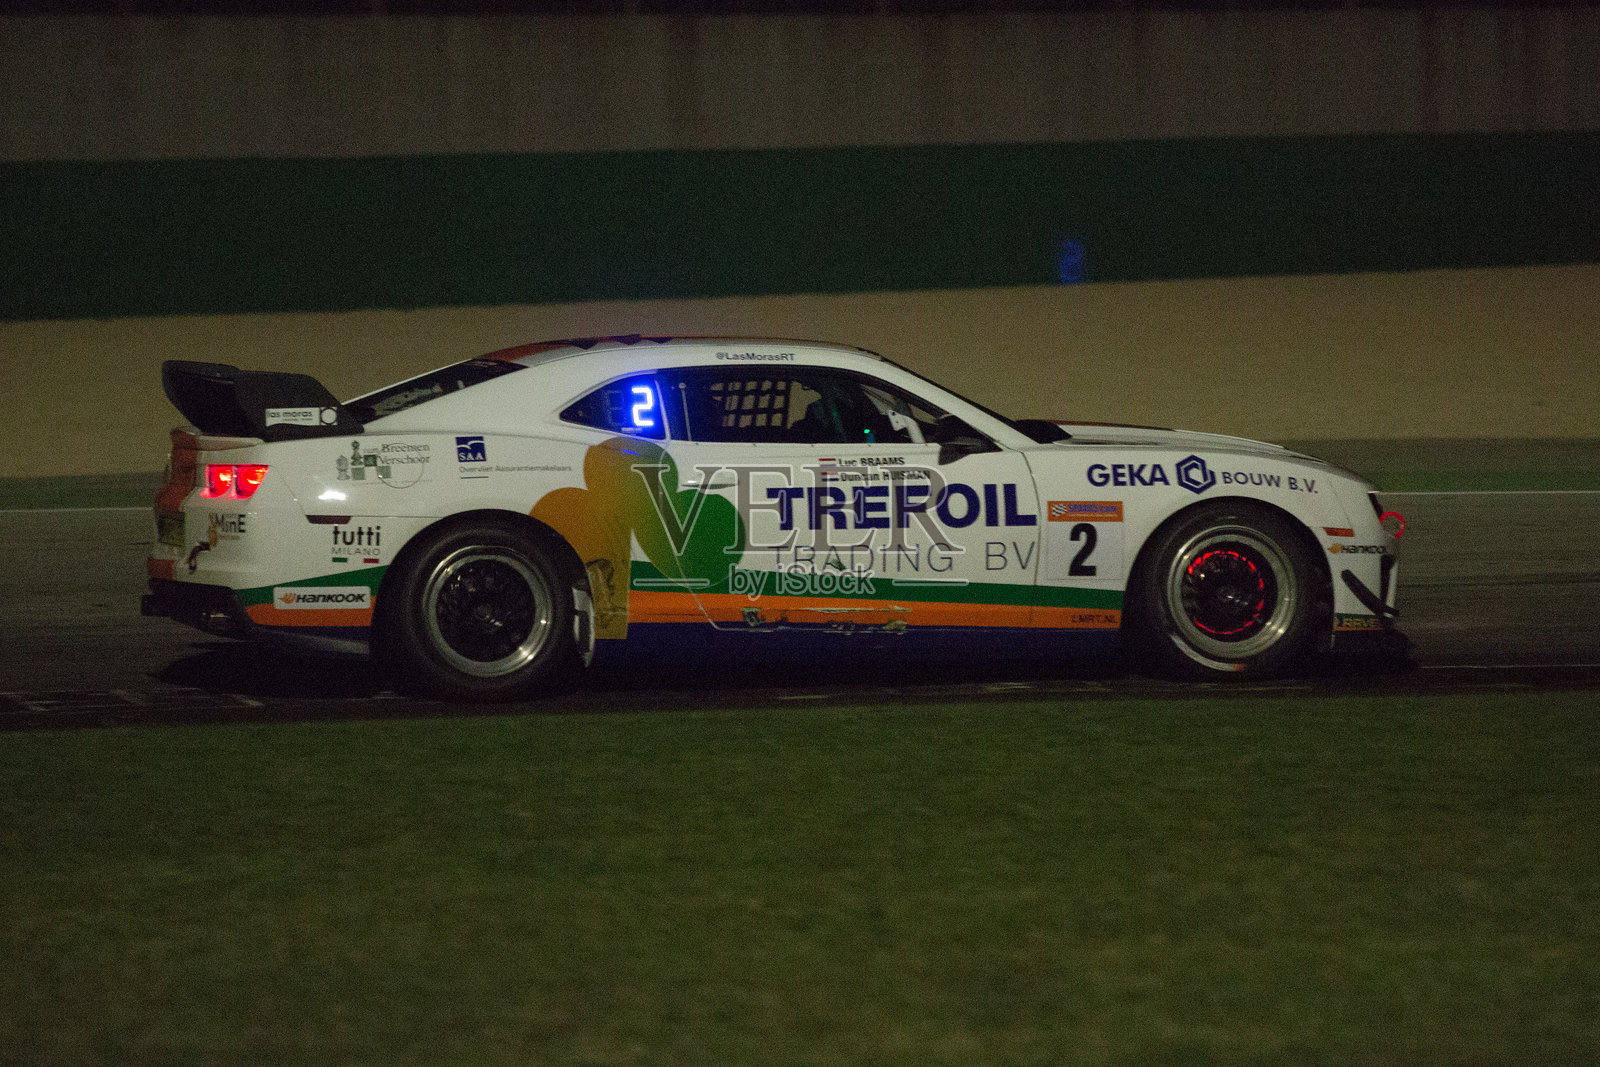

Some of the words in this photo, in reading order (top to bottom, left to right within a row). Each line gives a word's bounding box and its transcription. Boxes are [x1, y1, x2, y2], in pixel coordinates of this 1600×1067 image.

[716, 352, 795, 361] @LasMorasRT
[631, 384, 655, 427] 2
[459, 452, 485, 461] SAA
[860, 456, 905, 466] BRAAMS
[1087, 464, 1170, 487] GEKA
[1222, 471, 1281, 488] BOUW
[1289, 476, 1319, 494] B.V.
[766, 483, 1037, 531] TREFOIL
[333, 526, 380, 546] tutti
[332, 547, 380, 556] MILANO
[768, 540, 953, 576] TRADING
[985, 541, 1035, 571] BV
[1068, 523, 1097, 577] 2
